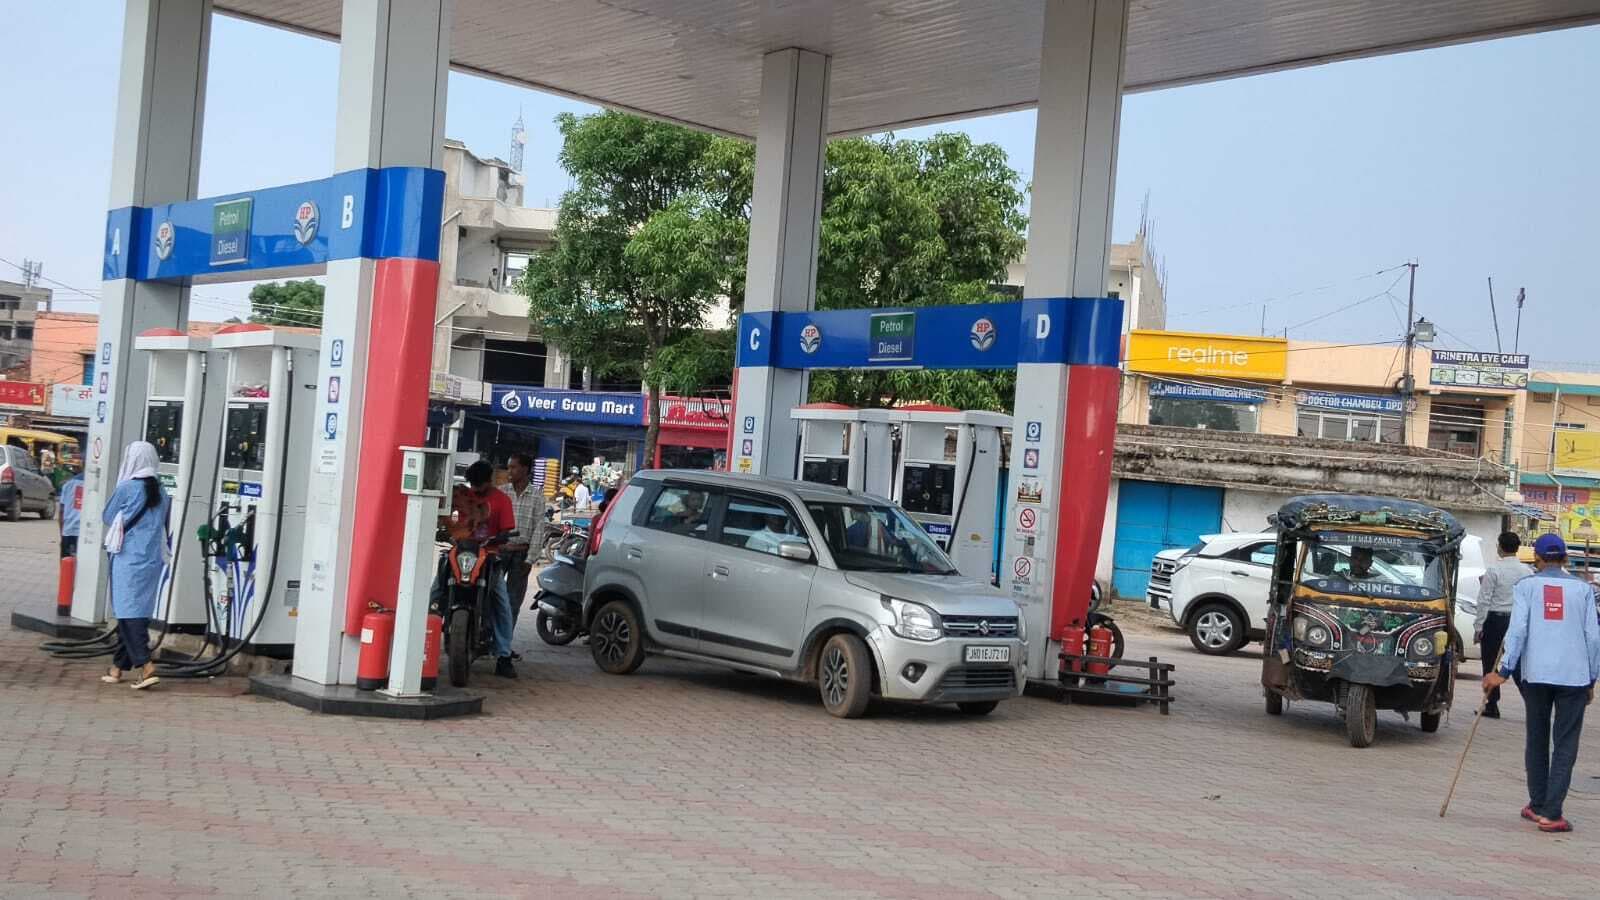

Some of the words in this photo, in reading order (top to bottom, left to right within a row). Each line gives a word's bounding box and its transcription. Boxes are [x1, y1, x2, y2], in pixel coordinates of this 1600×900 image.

[219, 210, 240, 226] Petrol
[299, 206, 311, 220] HP
[341, 195, 353, 229] B
[111, 228, 121, 255] A
[217, 238, 238, 256] Diesel
[805, 328, 816, 337] HP
[879, 319, 904, 333] Petrol
[976, 322, 990, 333] HP
[1036, 314, 1050, 339] D
[750, 328, 761, 351] C
[878, 342, 902, 354] Diesel
[1167, 345, 1248, 366] realme
[1434, 351, 1479, 362] TRINETRA
[1481, 354, 1499, 363] EYE
[1500, 355, 1527, 364] CARE
[527, 395, 556, 410] Veer
[562, 398, 596, 412] Grow
[601, 400, 635, 415] Mart
[1307, 396, 1340, 407] DOCTOR
[1386, 400, 1403, 411] OPD
[929, 524, 947, 534] Diesel
[1349, 582, 1401, 594] PRINCE
